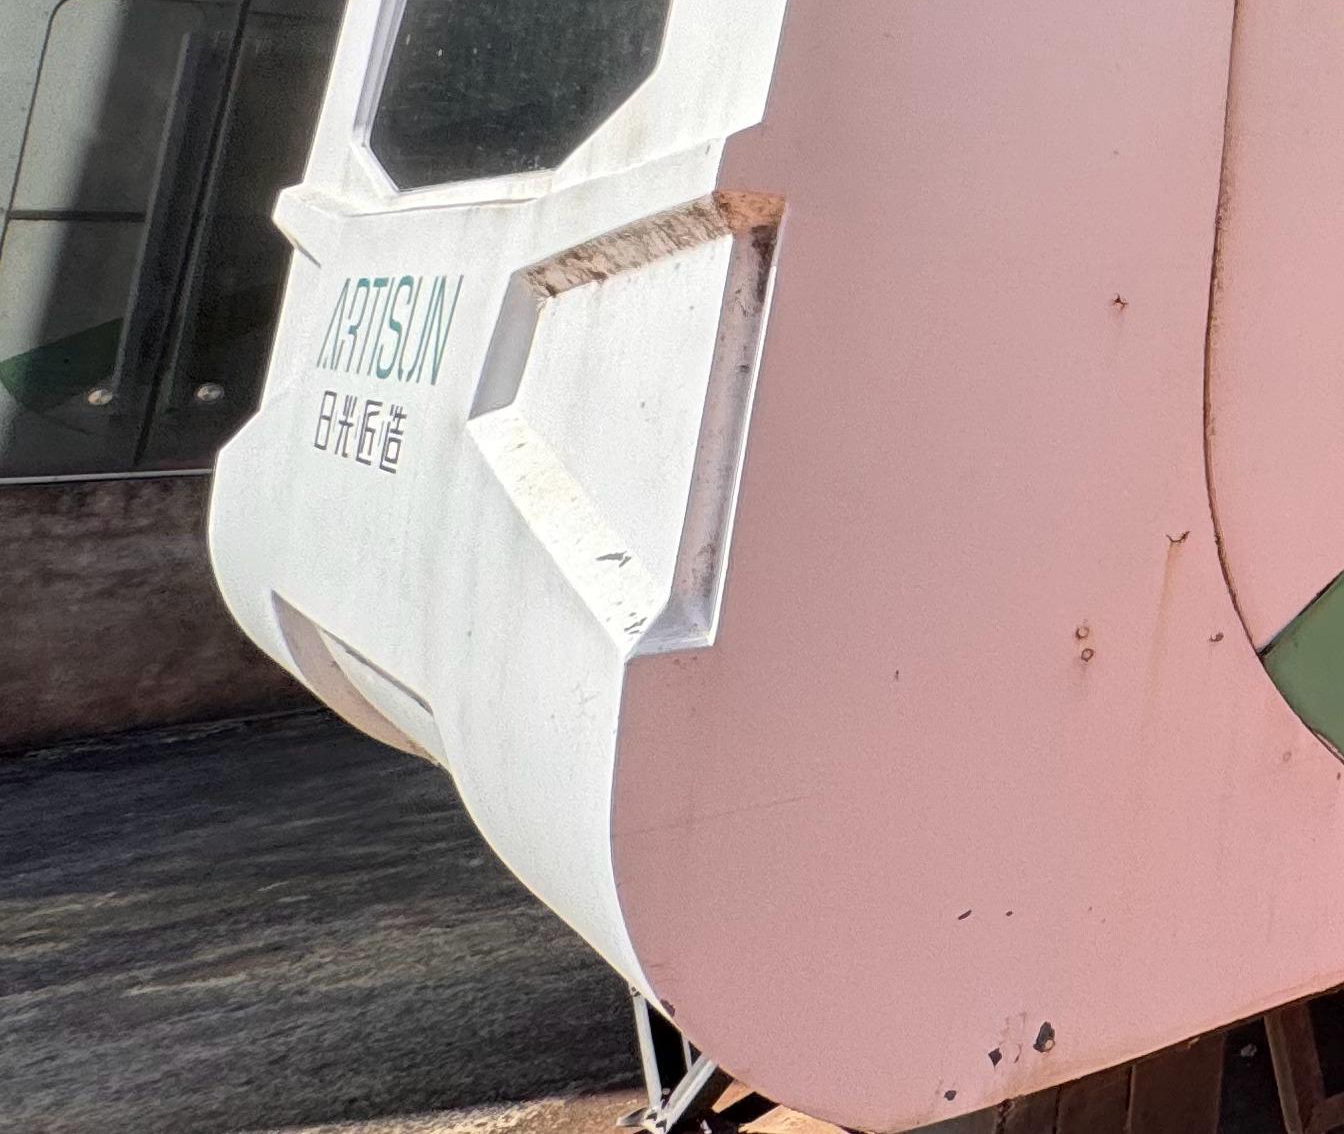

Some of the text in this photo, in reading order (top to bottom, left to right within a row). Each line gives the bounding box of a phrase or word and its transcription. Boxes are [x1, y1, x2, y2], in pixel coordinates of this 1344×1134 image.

[316, 274, 464, 385] ARTISUN
[314, 390, 407, 474] 日光匠造
